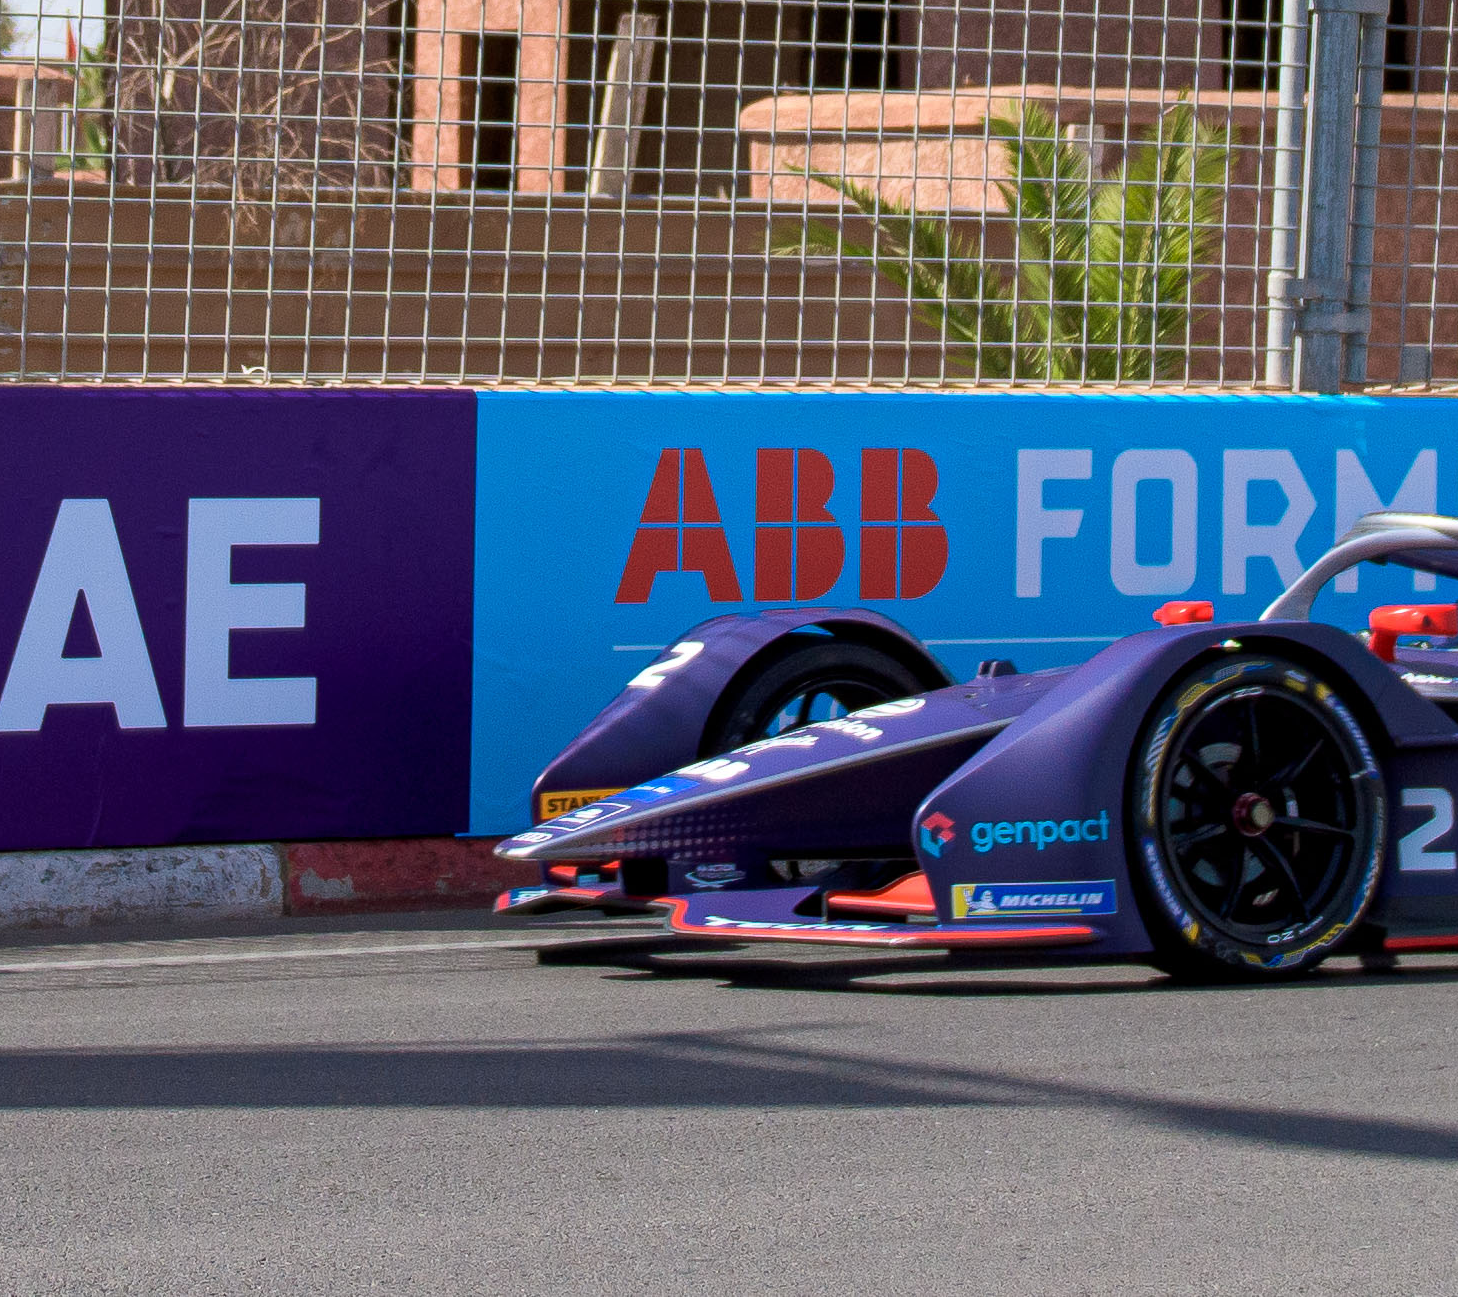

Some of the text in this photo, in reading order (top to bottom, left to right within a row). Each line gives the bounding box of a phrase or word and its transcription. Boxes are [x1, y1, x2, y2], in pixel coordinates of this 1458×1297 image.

[614, 448, 949, 604] ABB
[626, 641, 704, 688] 2
[970, 809, 1109, 853] genpact
[1397, 787, 1458, 872] 2
[1000, 892, 1104, 908] MICHELIN
